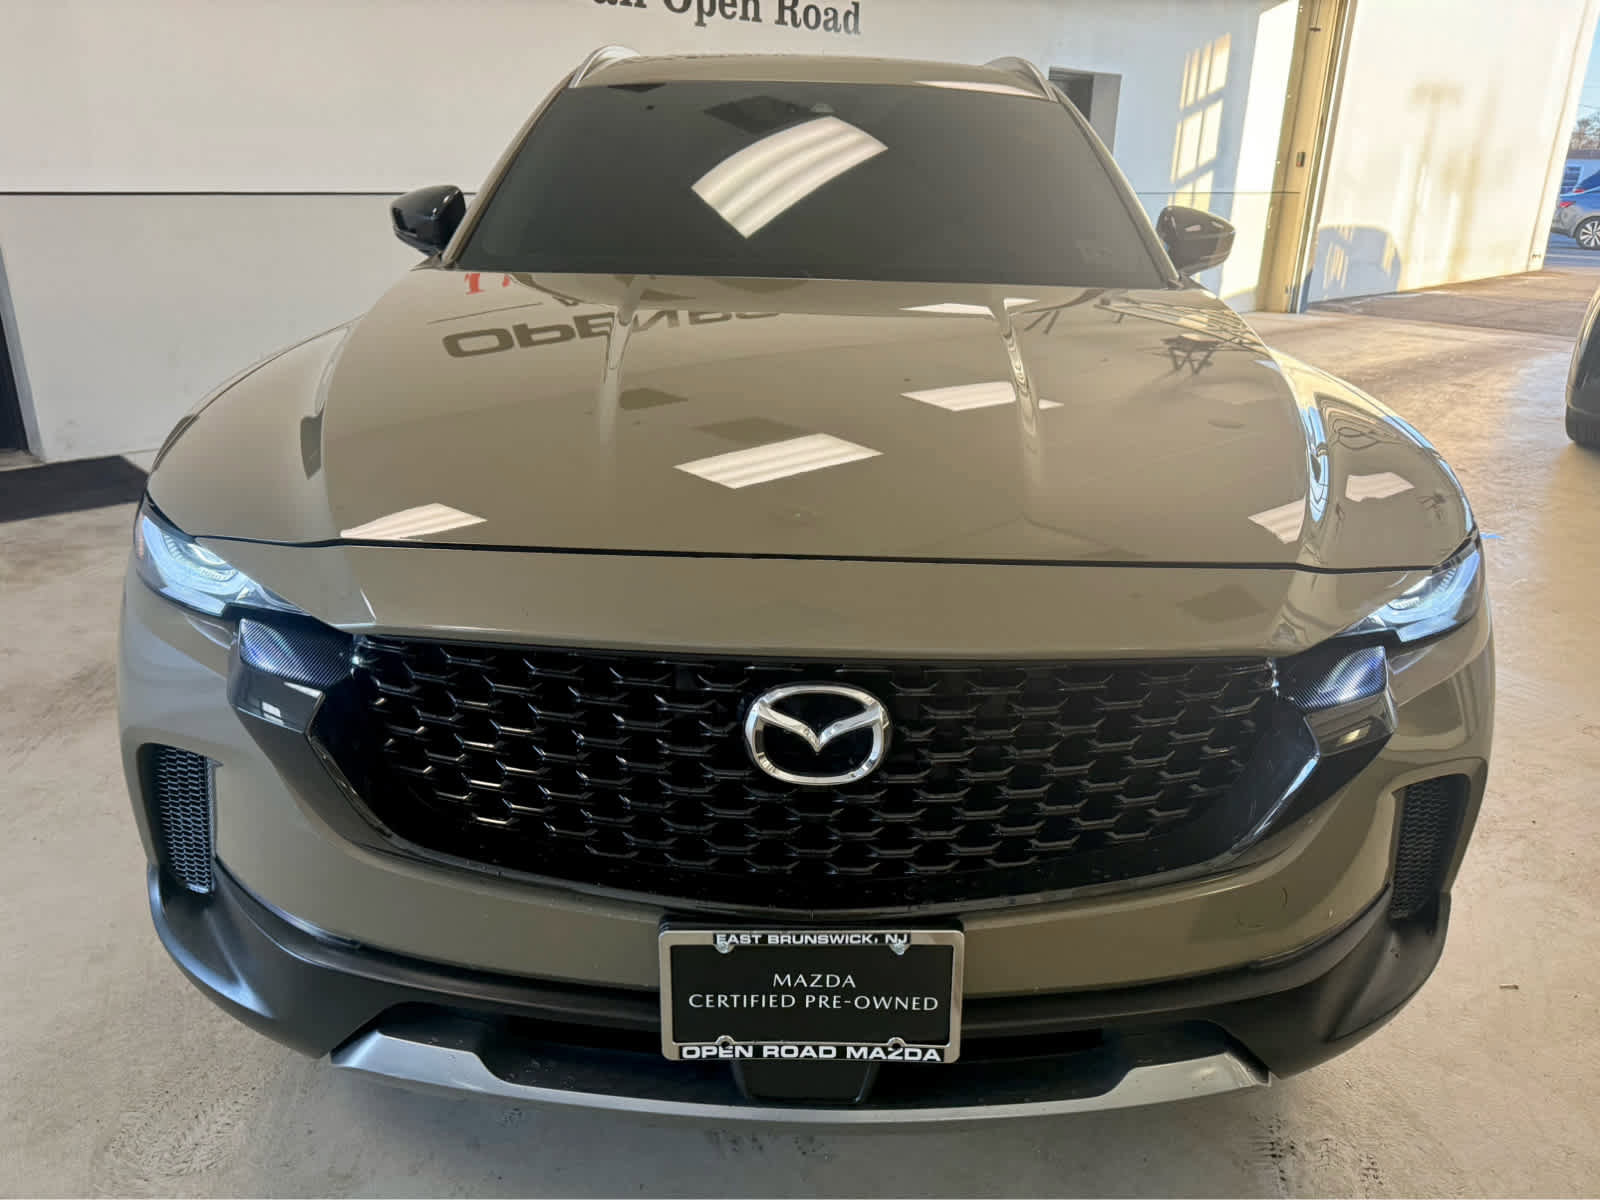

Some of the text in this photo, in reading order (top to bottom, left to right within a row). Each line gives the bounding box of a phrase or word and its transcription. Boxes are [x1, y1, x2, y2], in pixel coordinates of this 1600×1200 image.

[774, 0, 862, 35] Road
[716, 933, 909, 946] EAST BRUNSWICK, NJ
[773, 973, 857, 989] MAZDA
[688, 993, 939, 1012] CERTIFIED PRE-OWNED
[681, 1045, 943, 1062] OPEN ROAD MAZDA
